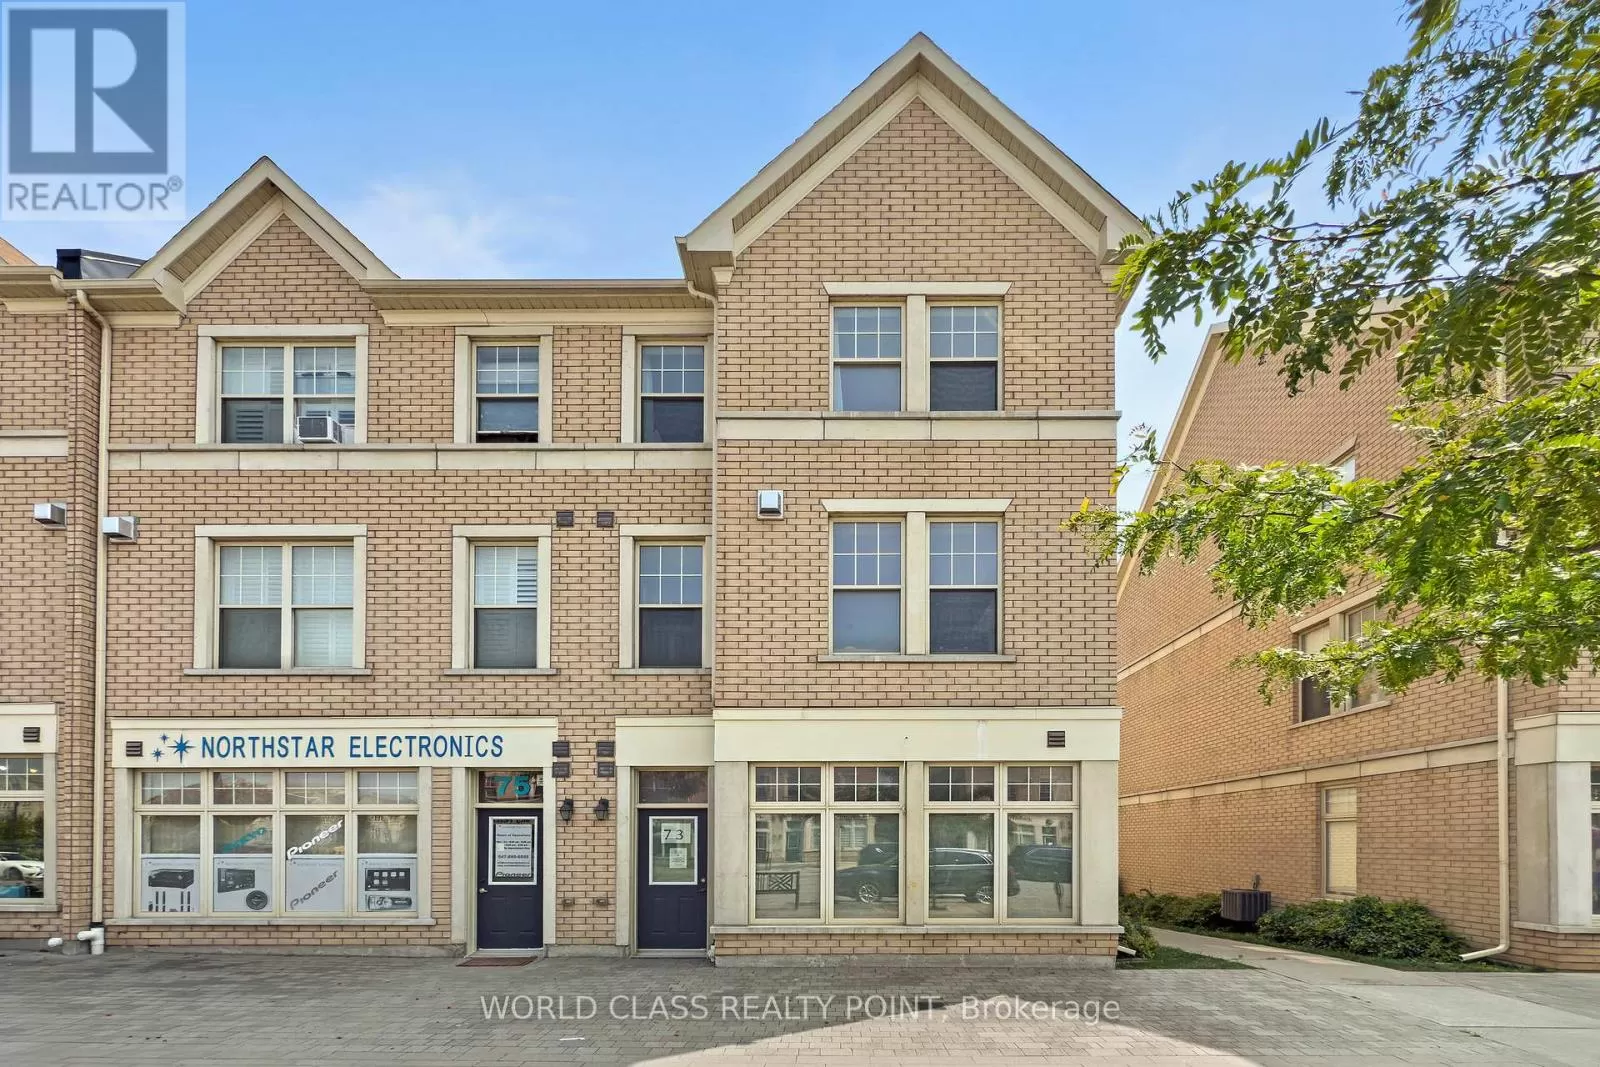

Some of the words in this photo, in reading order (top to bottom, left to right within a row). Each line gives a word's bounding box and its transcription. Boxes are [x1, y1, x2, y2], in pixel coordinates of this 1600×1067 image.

[201, 735, 335, 758] NORTHSTAR
[349, 735, 504, 758] ELECTRONICS
[493, 775, 531, 799] 75
[286, 819, 344, 861] Pioneer
[663, 829, 684, 840] 73
[290, 869, 339, 911] Pioneer
